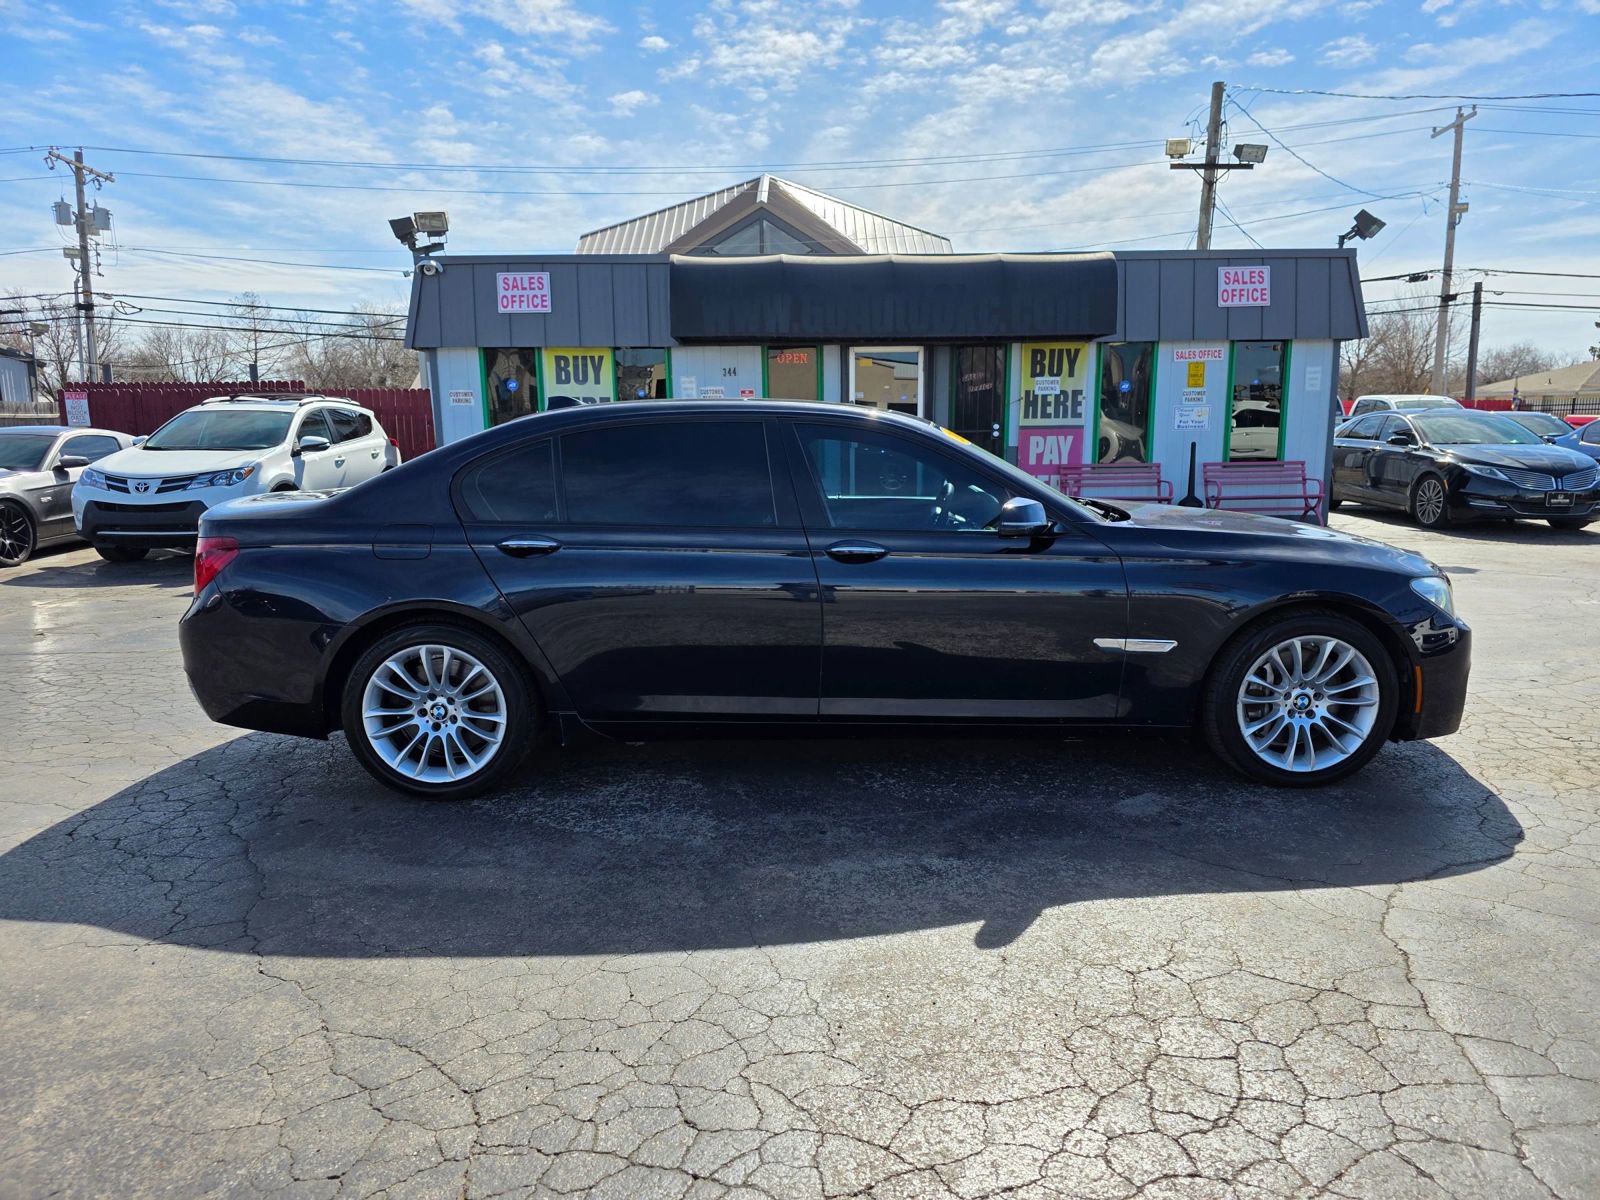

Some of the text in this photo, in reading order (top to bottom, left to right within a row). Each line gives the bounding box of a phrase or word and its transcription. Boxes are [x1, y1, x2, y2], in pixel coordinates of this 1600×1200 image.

[502, 276, 545, 291] SALES
[1223, 270, 1265, 285] SALES
[501, 294, 548, 309] OFFICE
[1221, 288, 1267, 303] OFFICE
[776, 352, 809, 364] OPEN
[1175, 349, 1222, 360] SALES OFFICE
[554, 355, 604, 385] BUY
[1029, 348, 1081, 378] BUY
[722, 367, 737, 377] 344
[1023, 390, 1082, 419] HERE
[1029, 435, 1074, 465] PAY
